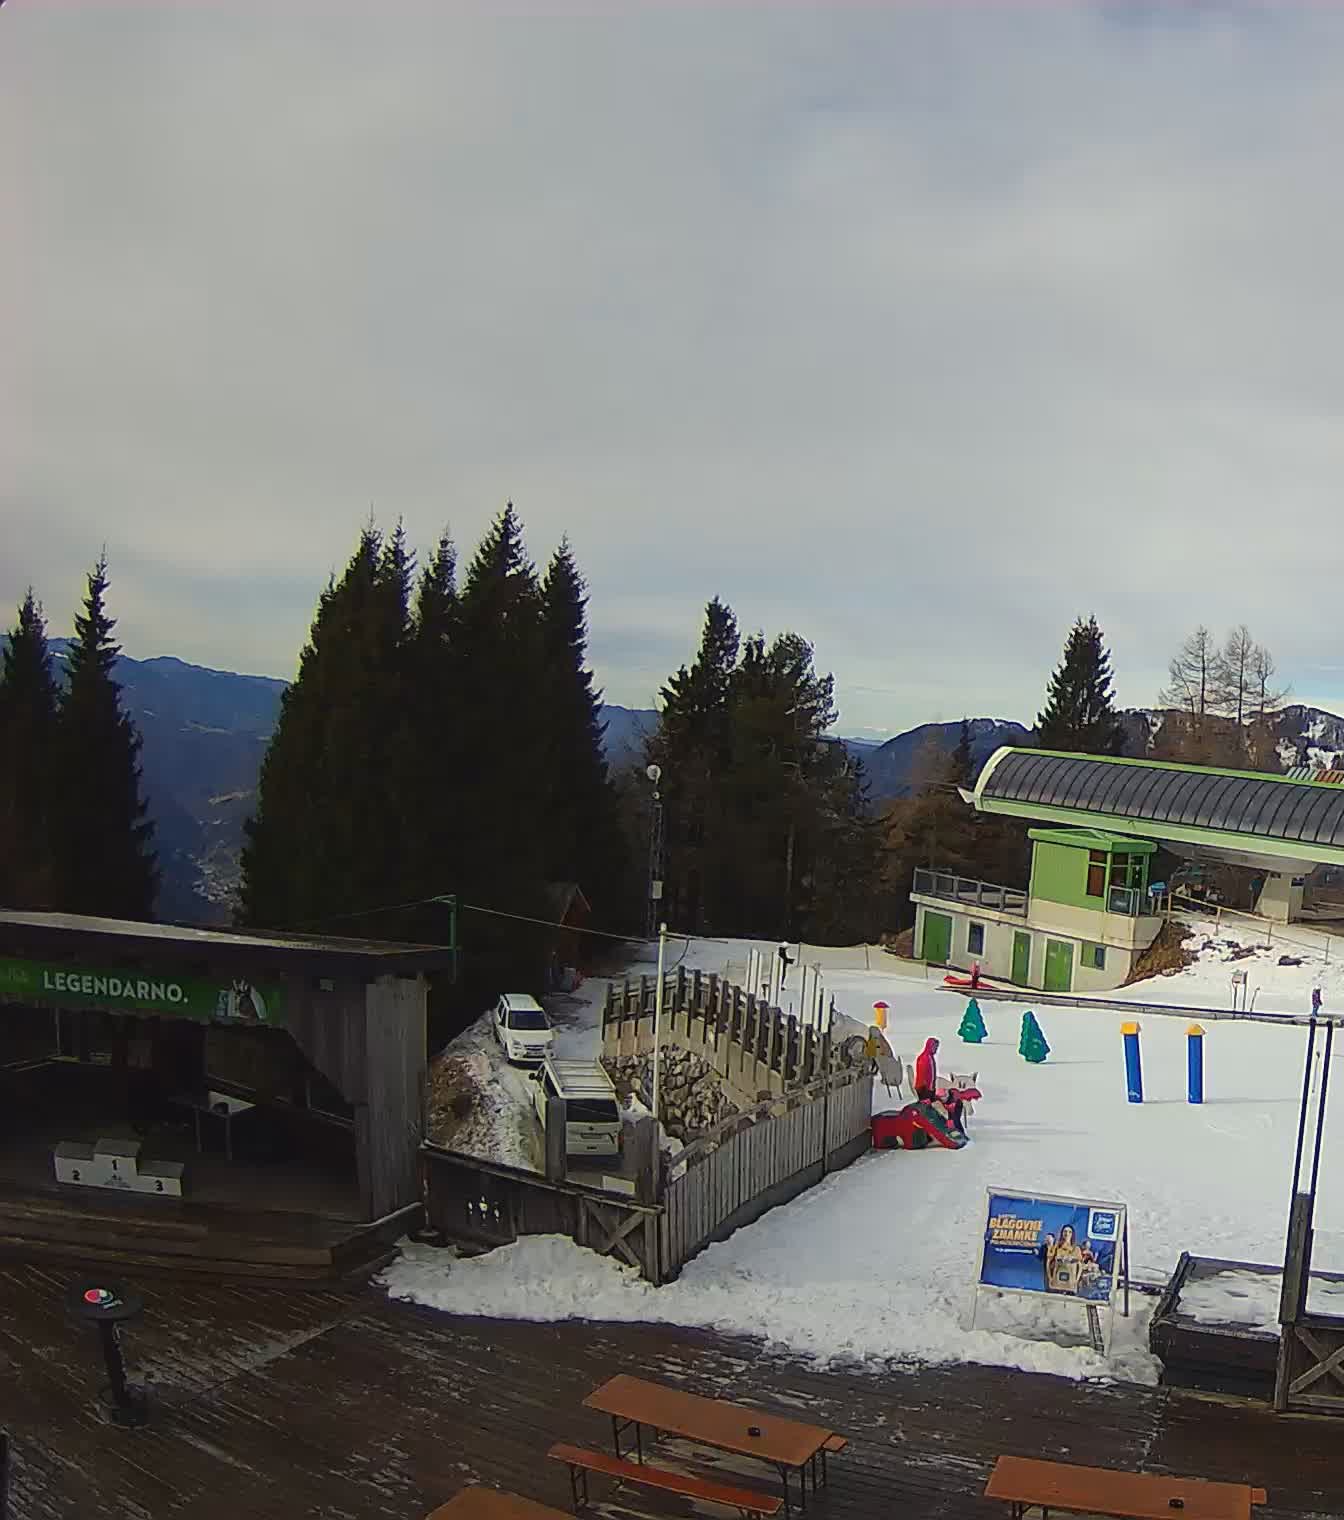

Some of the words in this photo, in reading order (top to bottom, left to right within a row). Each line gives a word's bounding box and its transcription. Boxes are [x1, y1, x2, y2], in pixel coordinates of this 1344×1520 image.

[43, 970, 189, 1004] LEGENDARNO.
[111, 1159, 118, 1171] 1
[72, 1169, 82, 1182] 2
[156, 1179, 165, 1192] 3
